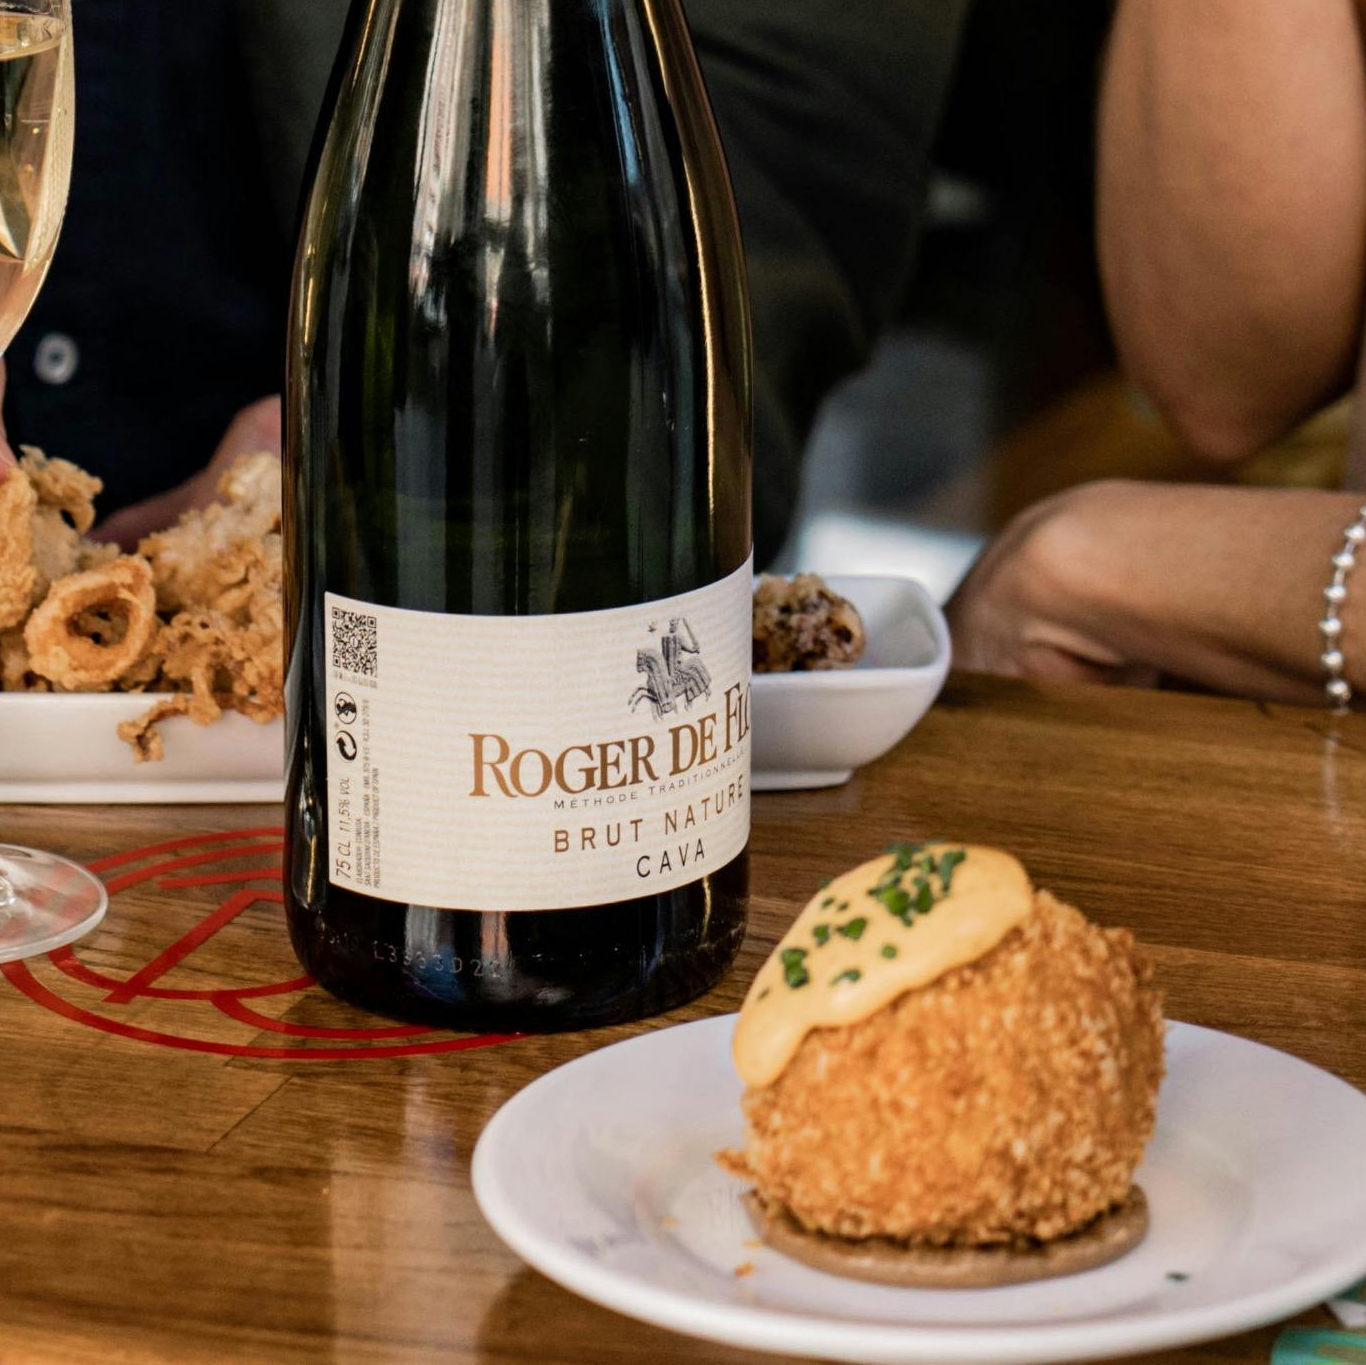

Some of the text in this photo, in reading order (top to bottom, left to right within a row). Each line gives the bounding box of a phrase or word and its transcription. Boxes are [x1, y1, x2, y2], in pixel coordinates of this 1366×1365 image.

[468, 732, 659, 799] ROGER
[668, 712, 718, 777] DE
[649, 745, 746, 794] TRADITIONNELLE
[336, 777, 352, 879] 75 CL 11,5% VOL
[554, 773, 744, 853] BRUT NATURE
[636, 837, 706, 879] CAVA
